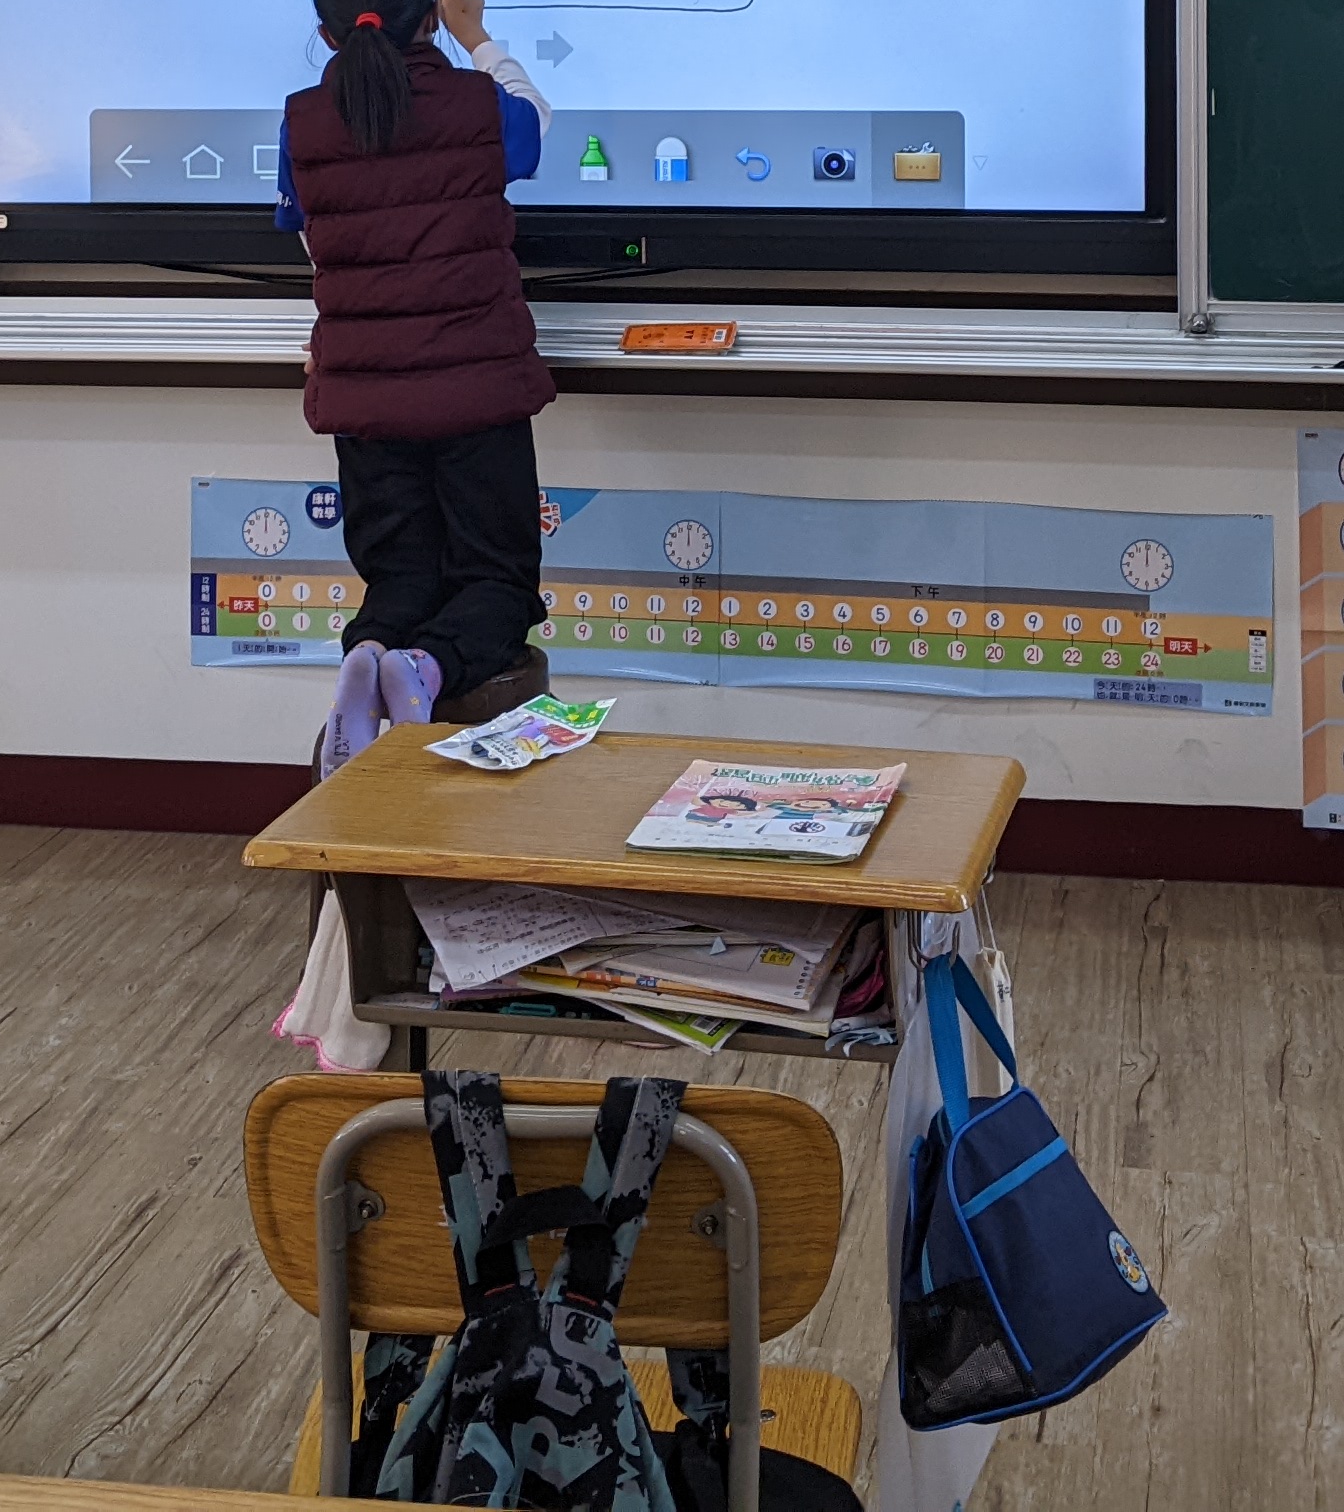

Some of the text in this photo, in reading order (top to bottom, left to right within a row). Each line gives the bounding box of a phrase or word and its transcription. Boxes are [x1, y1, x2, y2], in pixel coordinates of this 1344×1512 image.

[679, 574, 707, 587] 中午
[911, 585, 940, 598] 下午
[233, 600, 255, 611] 昨天
[262, 584, 272, 598] 0
[333, 586, 341, 600] 2
[543, 593, 553, 605] 8
[578, 594, 588, 608] 9
[612, 596, 628, 610] 10
[650, 597, 661, 612] 11
[685, 599, 700, 613] 12
[763, 602, 772, 616] 2
[800, 603, 810, 618] 3
[837, 606, 848, 620] 4
[876, 607, 886, 622] 5
[913, 609, 924, 624] 6
[952, 611, 962, 625] 7
[990, 613, 1000, 627] 8
[1028, 614, 1038, 629] 9
[1065, 617, 1082, 632] 10
[1106, 619, 1118, 634] 11
[1143, 621, 1159, 636] 12
[262, 614, 272, 628] 0
[332, 615, 341, 629] 2
[542, 622, 552, 637] 8
[578, 624, 588, 638] 9
[612, 626, 628, 640] 10
[650, 627, 661, 642] 11
[685, 629, 700, 643] 12
[723, 632, 738, 647] 13
[760, 634, 775, 648] 14
[797, 636, 813, 650] 15
[835, 638, 851, 652] 16
[873, 639, 888, 654] 17
[912, 641, 927, 656] 18
[950, 643, 965, 658] 19
[986, 645, 1004, 660] 20
[1026, 647, 1039, 662] 21
[1064, 649, 1081, 664] 22
[1103, 651, 1120, 666] 23
[1143, 654, 1159, 668] 24
[1168, 639, 1194, 654] 明天
